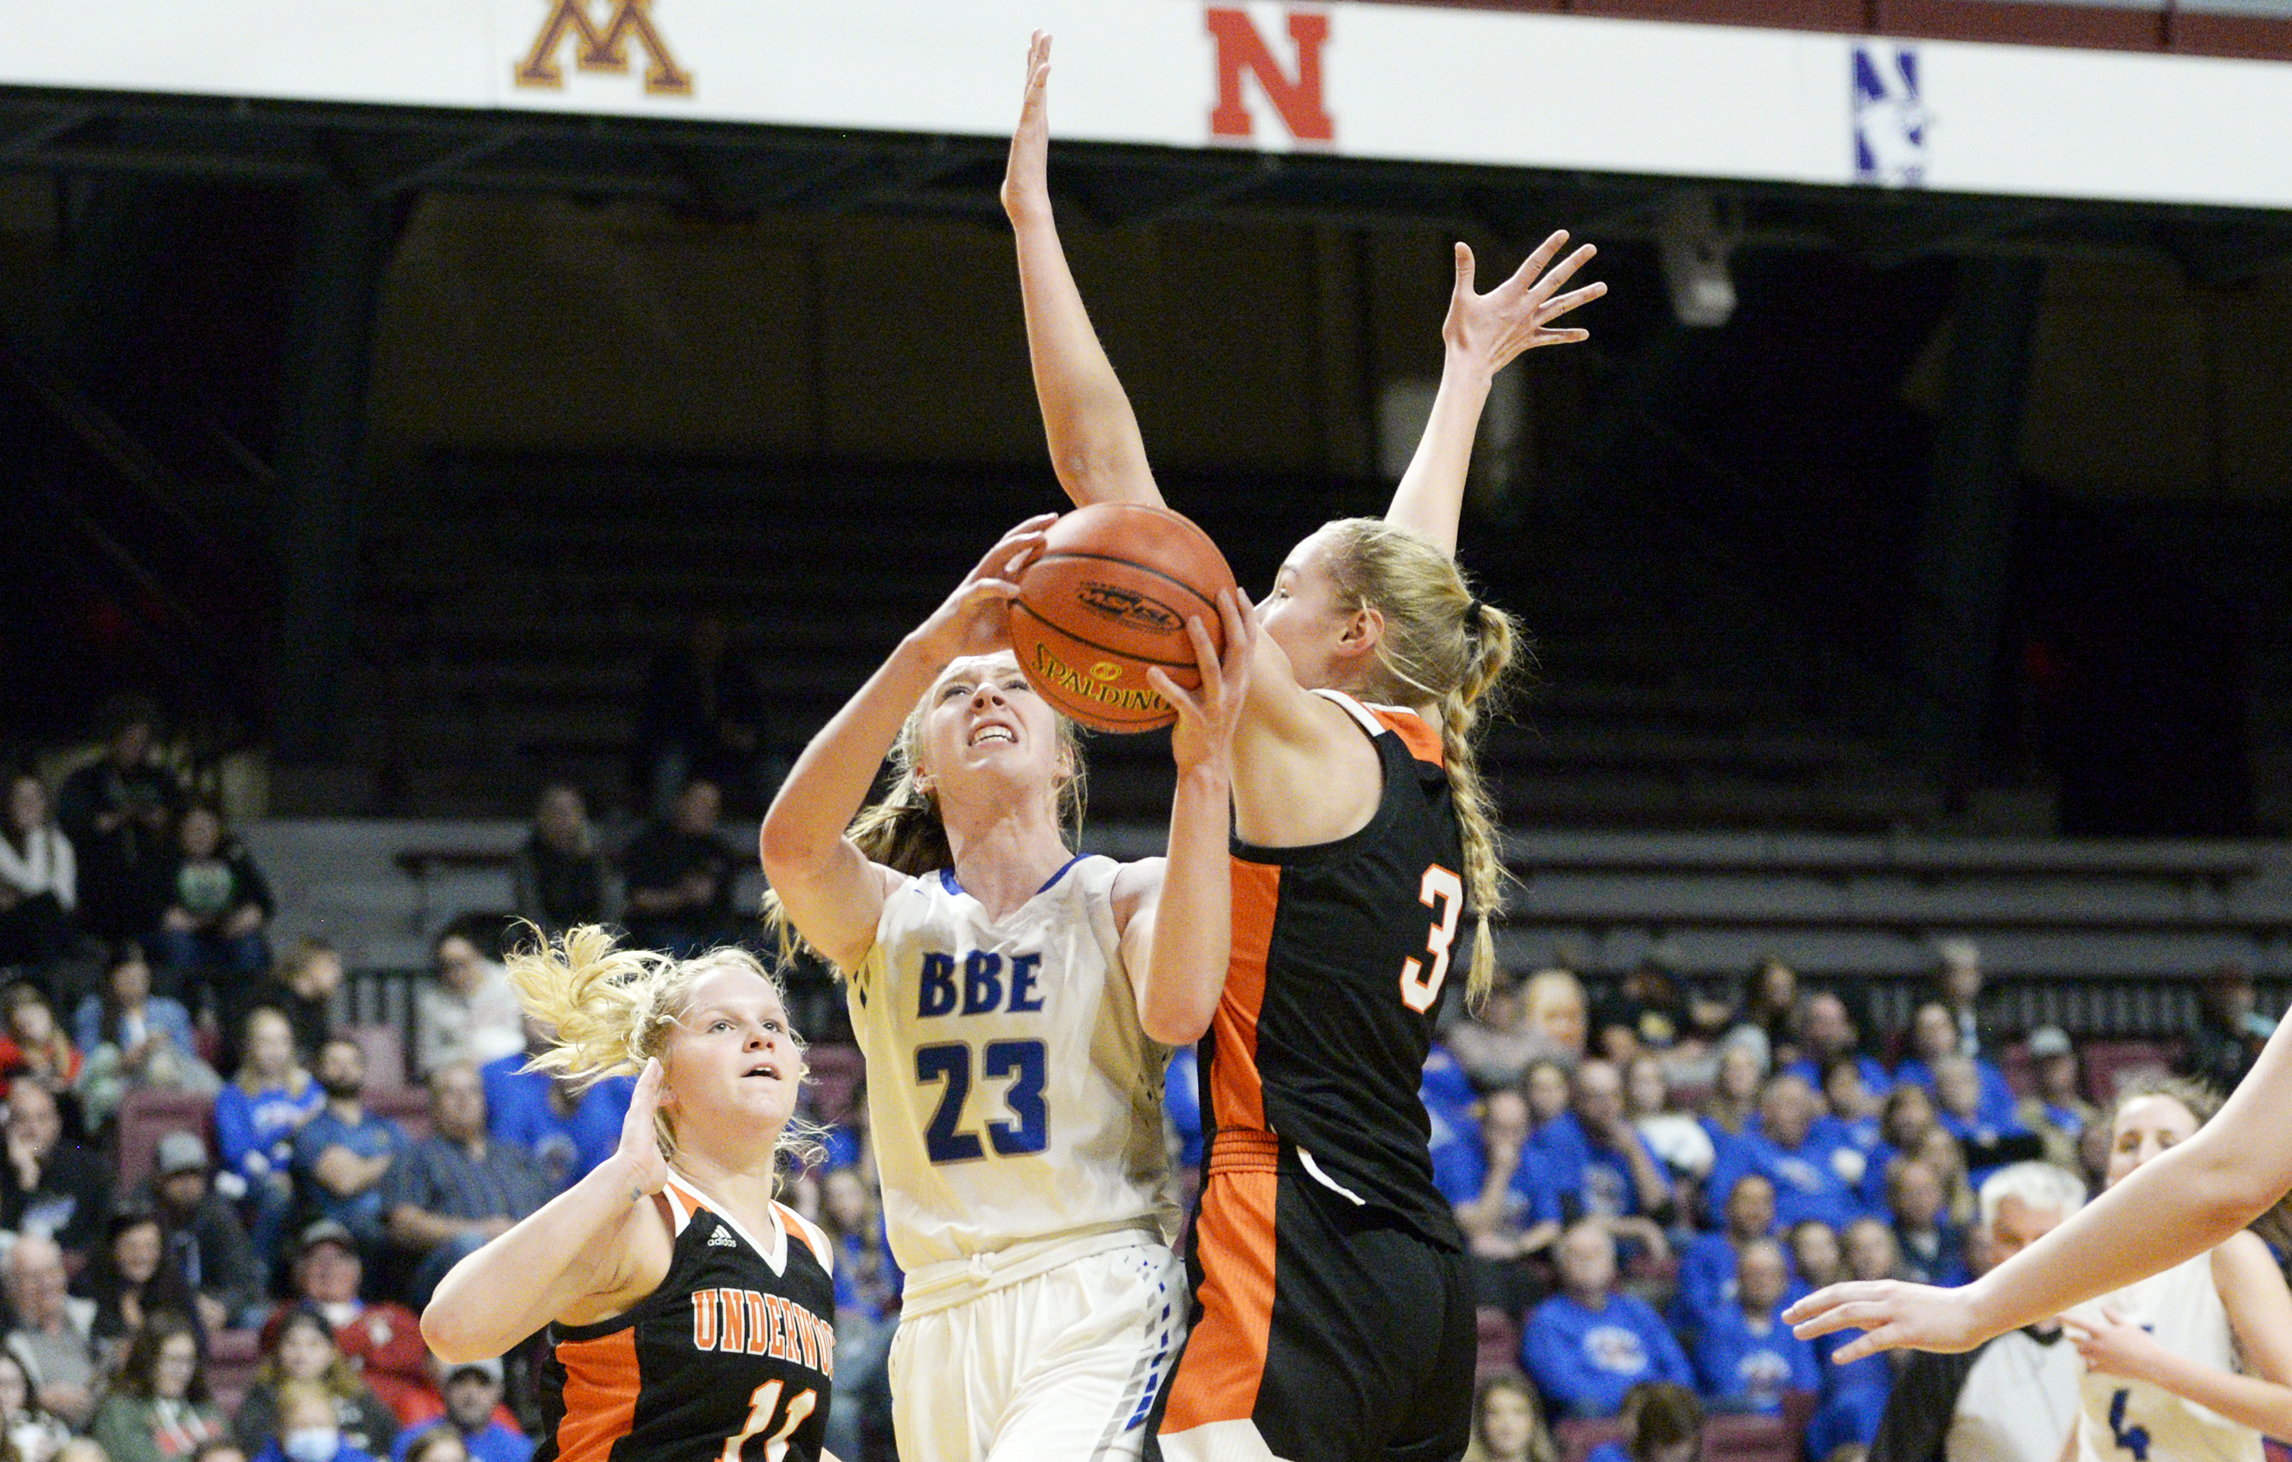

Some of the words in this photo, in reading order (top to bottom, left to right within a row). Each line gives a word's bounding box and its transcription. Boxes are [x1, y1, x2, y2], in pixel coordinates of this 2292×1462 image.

[1206, 4, 1337, 145] N
[916, 950, 1045, 1019] BBE
[1400, 863, 1463, 1014] 3
[914, 1037, 1051, 1166] 23
[707, 1237, 737, 1248] adidas
[713, 1378, 818, 1462] 11
